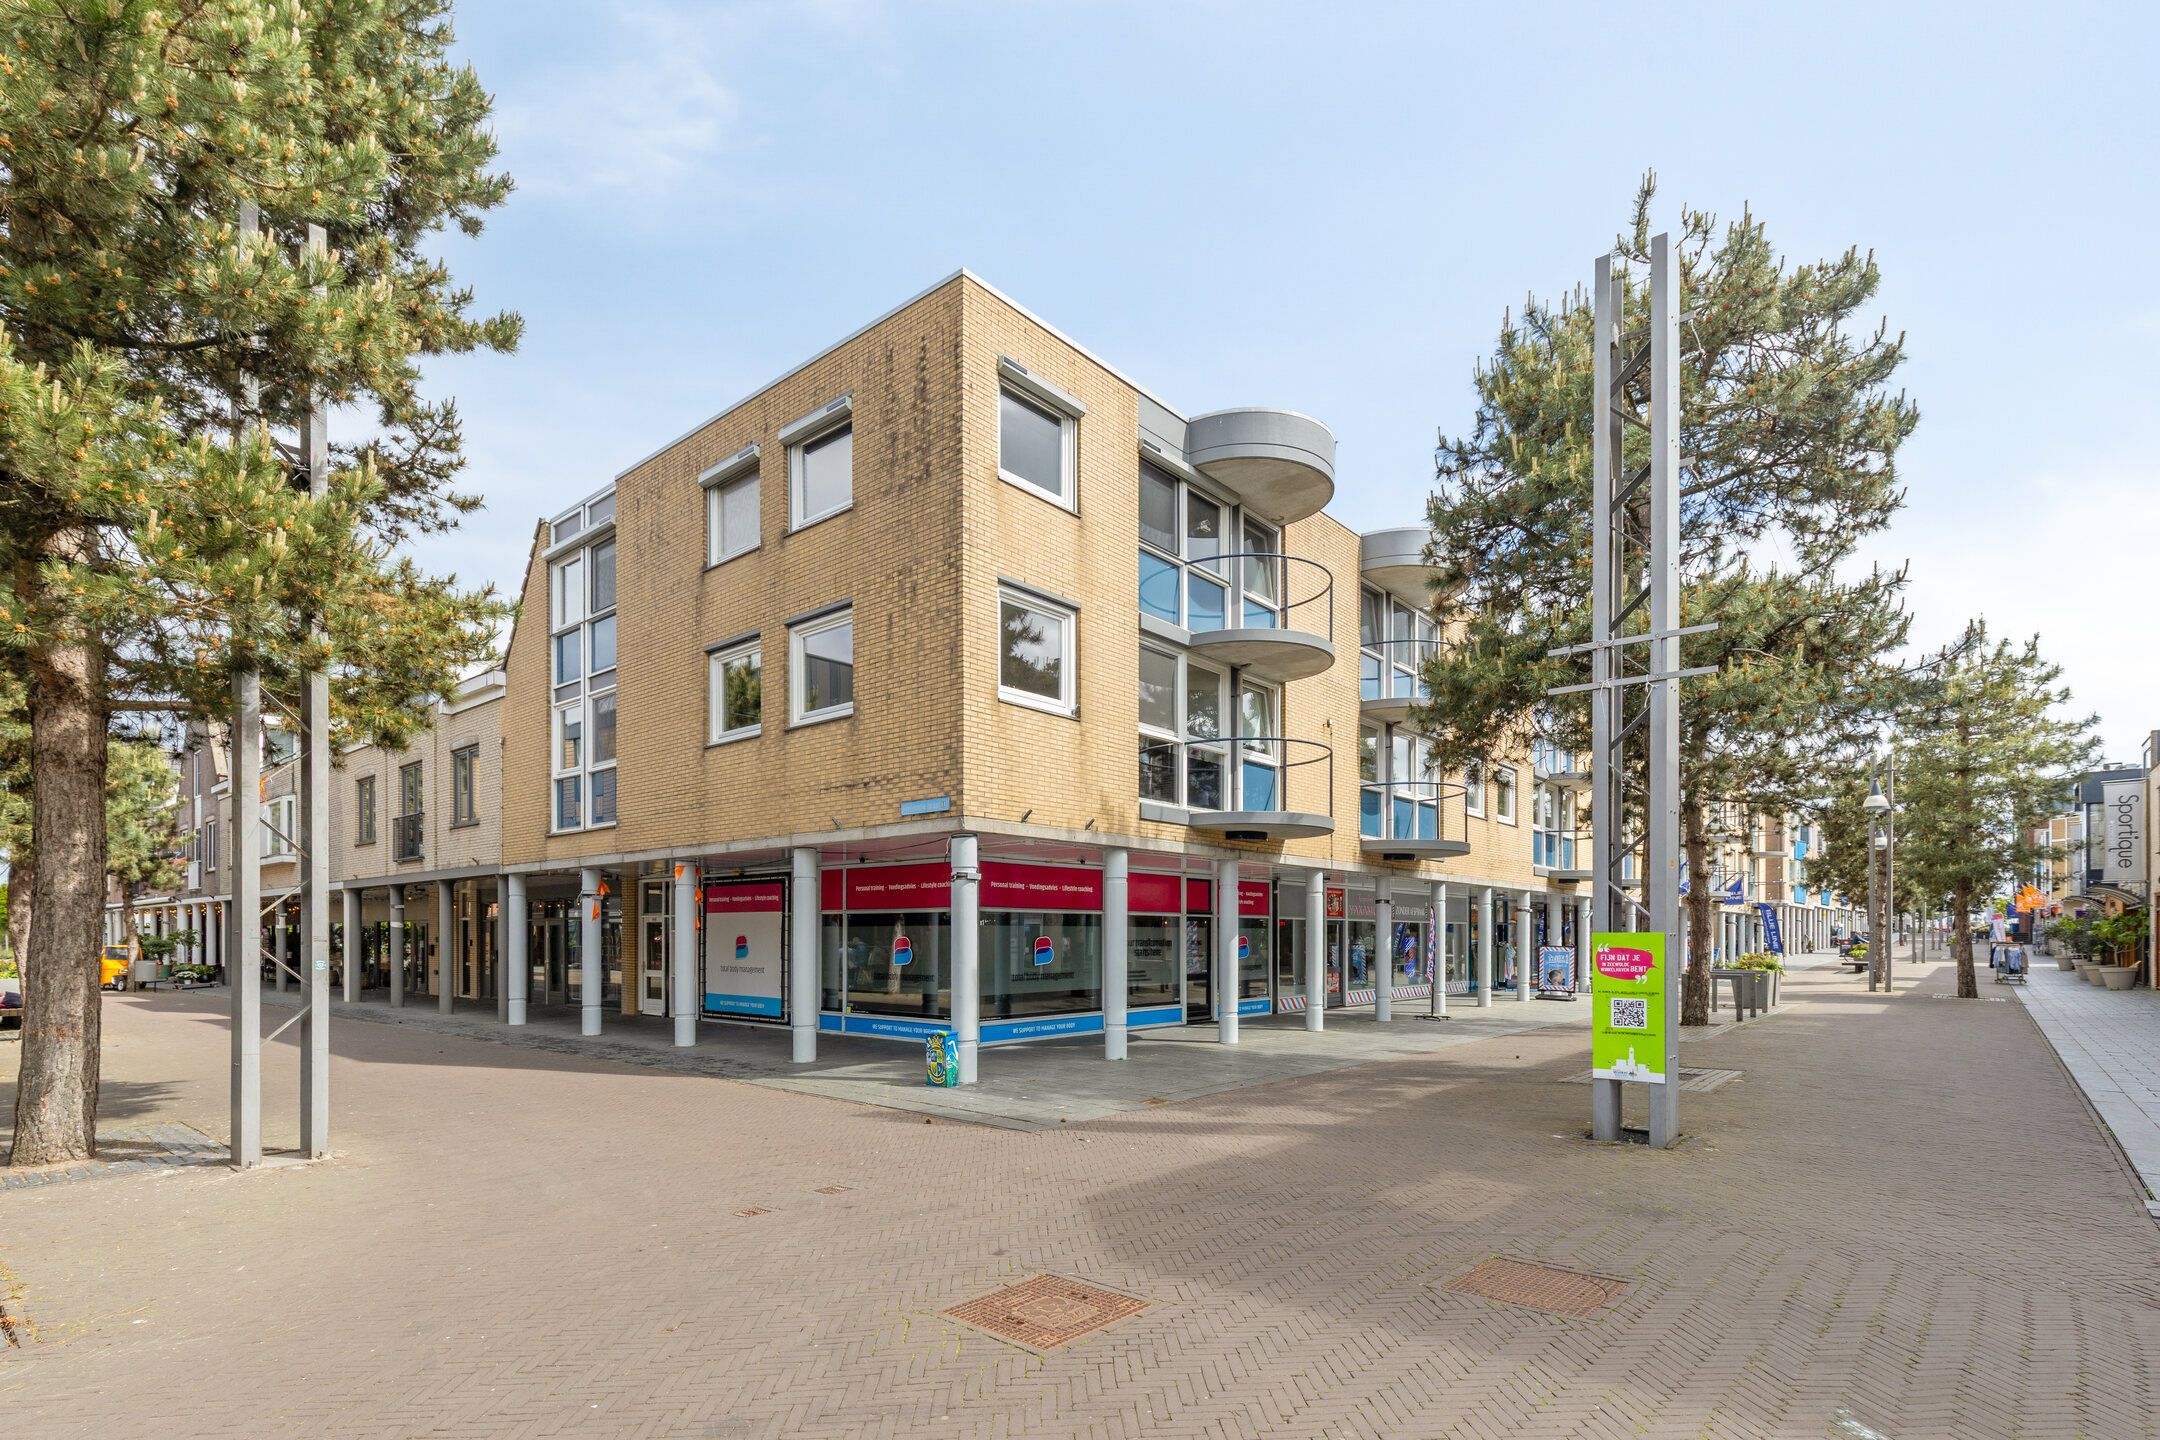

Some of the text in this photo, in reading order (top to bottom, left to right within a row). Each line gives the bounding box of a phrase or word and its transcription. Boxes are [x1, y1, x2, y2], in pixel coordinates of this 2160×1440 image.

[2108, 794, 2139, 868] Sportique
[1766, 910, 1775, 930] BLUE
[1771, 930, 1780, 949] LINE
